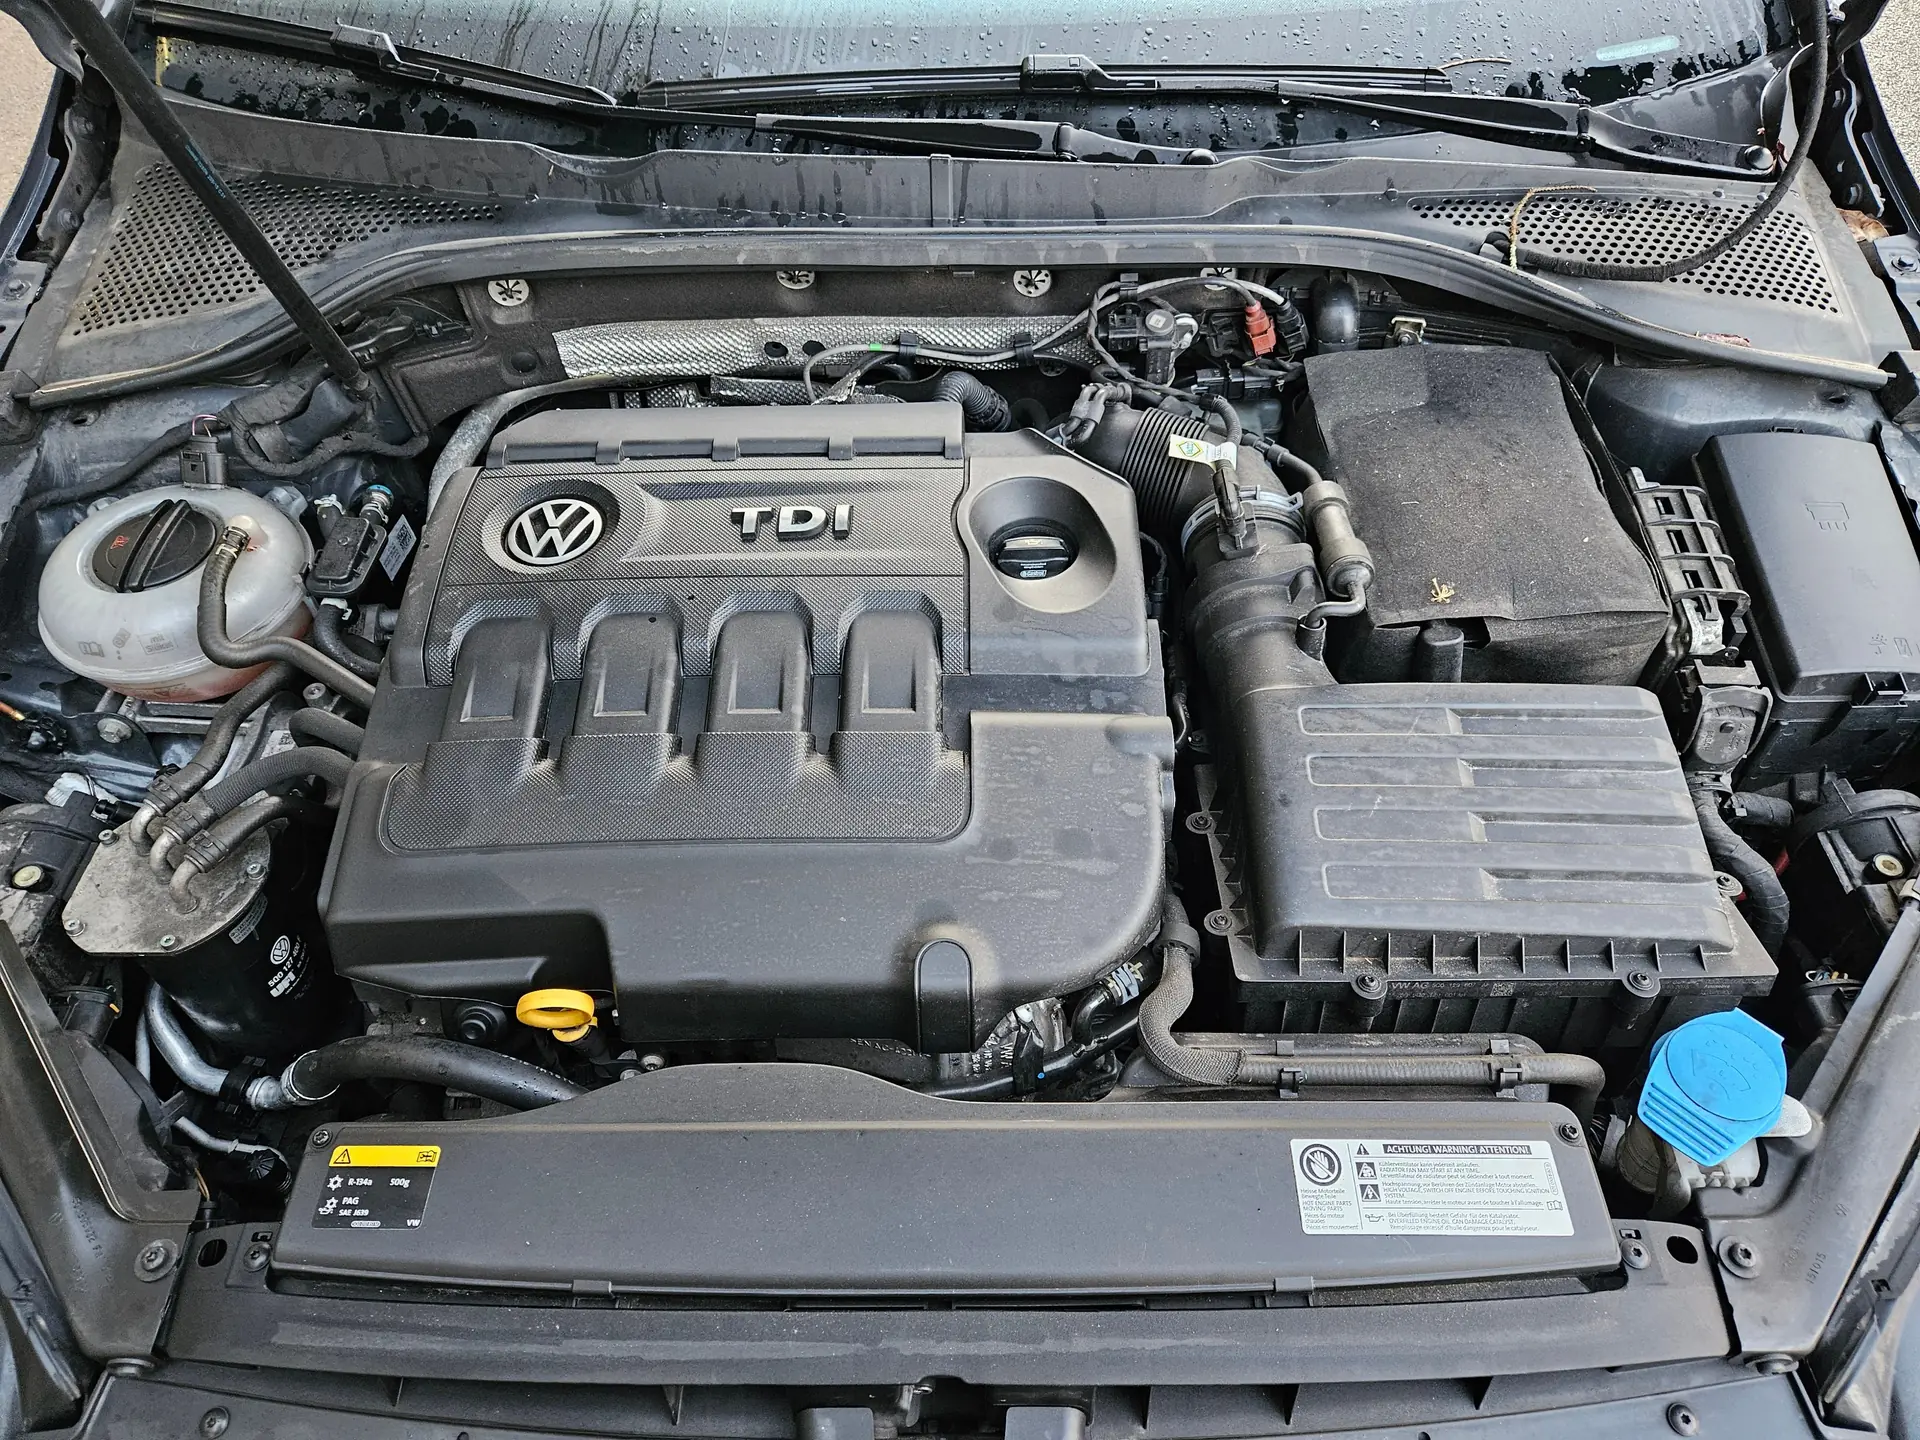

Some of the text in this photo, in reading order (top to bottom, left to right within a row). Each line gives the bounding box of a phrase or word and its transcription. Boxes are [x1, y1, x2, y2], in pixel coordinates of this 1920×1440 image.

[731, 504, 853, 540] TDI
[282, 956, 294, 971] 127
[1386, 1145, 1529, 1154] ACHTUNG! WARNING! ATTENTION!
[389, 1178, 410, 1188] 500g
[341, 1197, 360, 1205] PAG
[338, 1208, 370, 1216] SAE J639
[406, 1219, 421, 1227] VW
